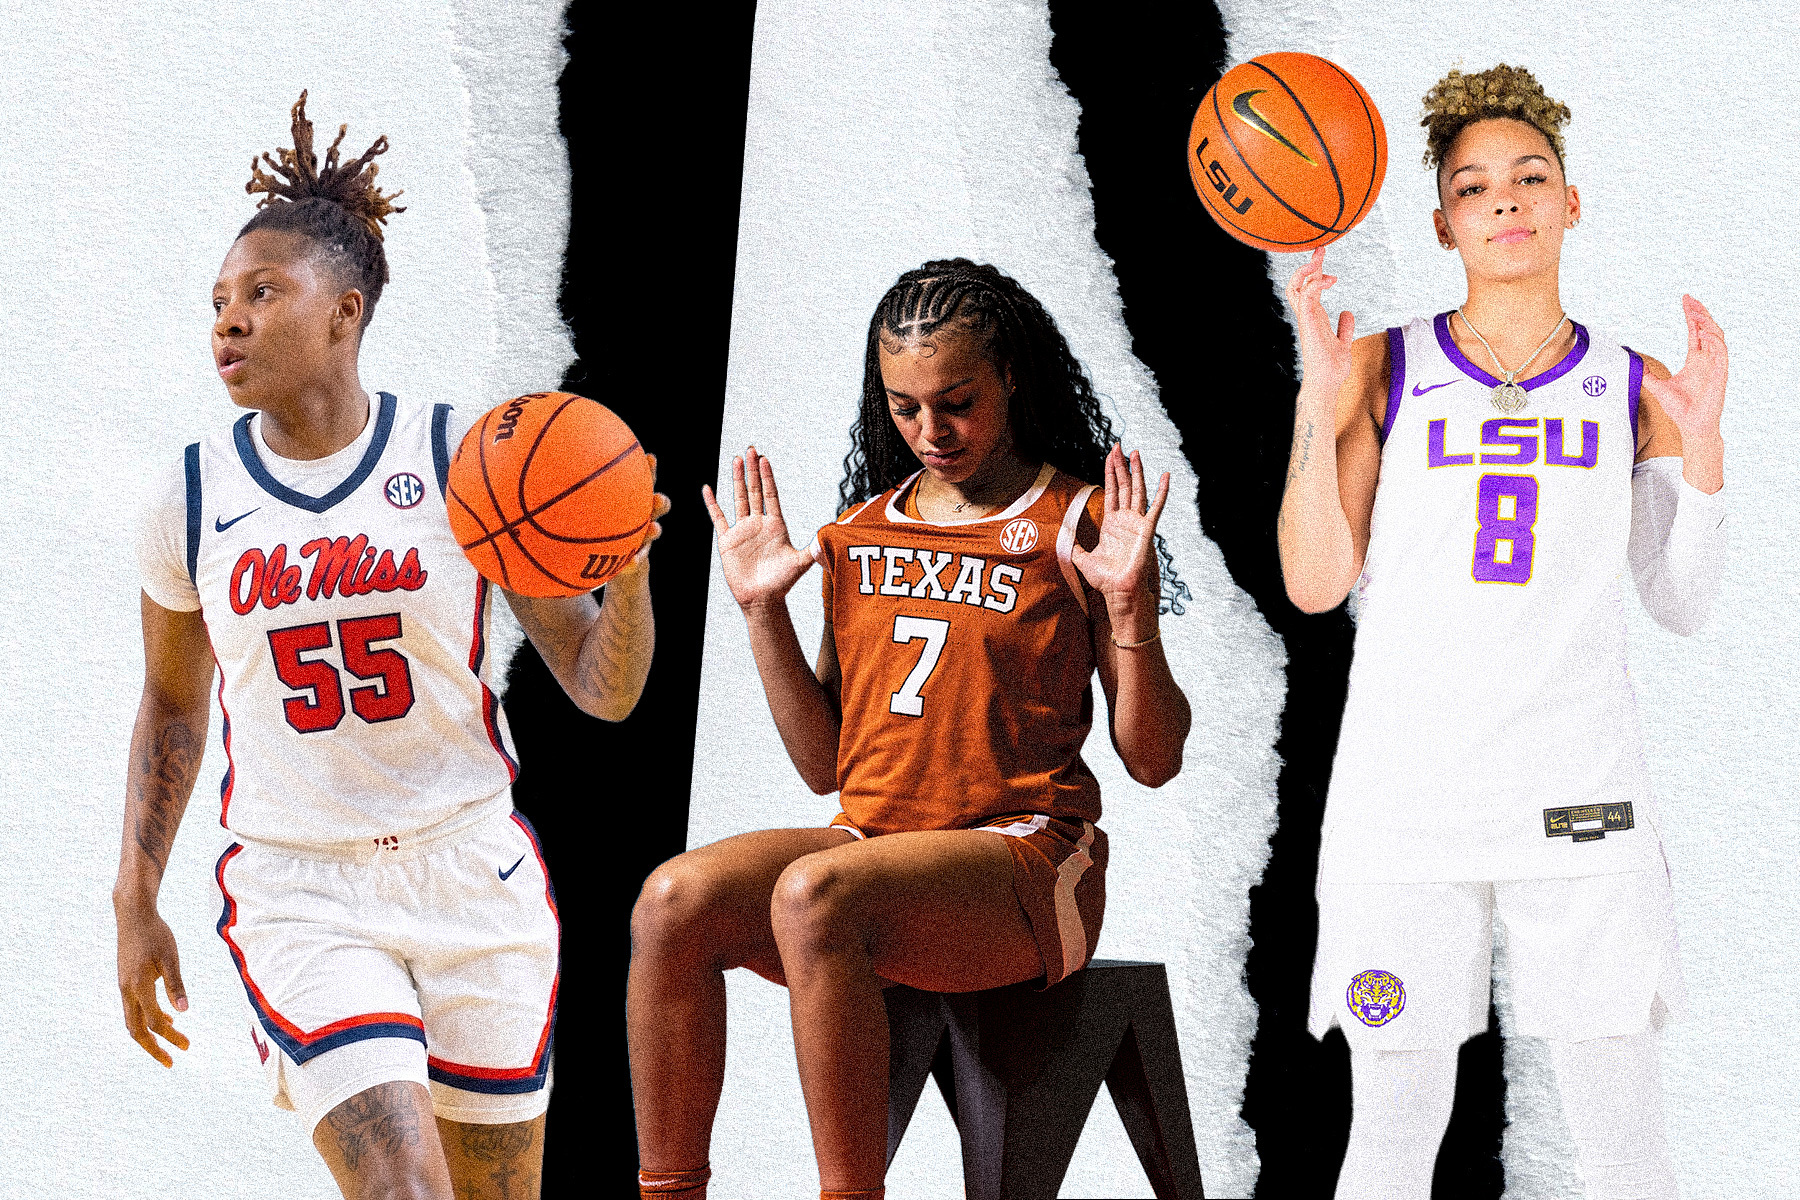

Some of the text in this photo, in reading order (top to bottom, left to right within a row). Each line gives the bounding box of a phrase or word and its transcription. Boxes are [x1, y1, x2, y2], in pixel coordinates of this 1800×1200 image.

[1196, 137, 1254, 215] LSU
[1583, 376, 1607, 397] SEC
[1427, 417, 1600, 470] LSU
[387, 473, 421, 508] SEC
[1002, 519, 1036, 553] SEC
[1470, 472, 1540, 587] 8
[230, 533, 428, 616] Ole Miss
[848, 545, 1024, 614] TEXAS
[266, 612, 416, 735] 55
[889, 614, 951, 718] 7
[1607, 811, 1621, 823] 44
